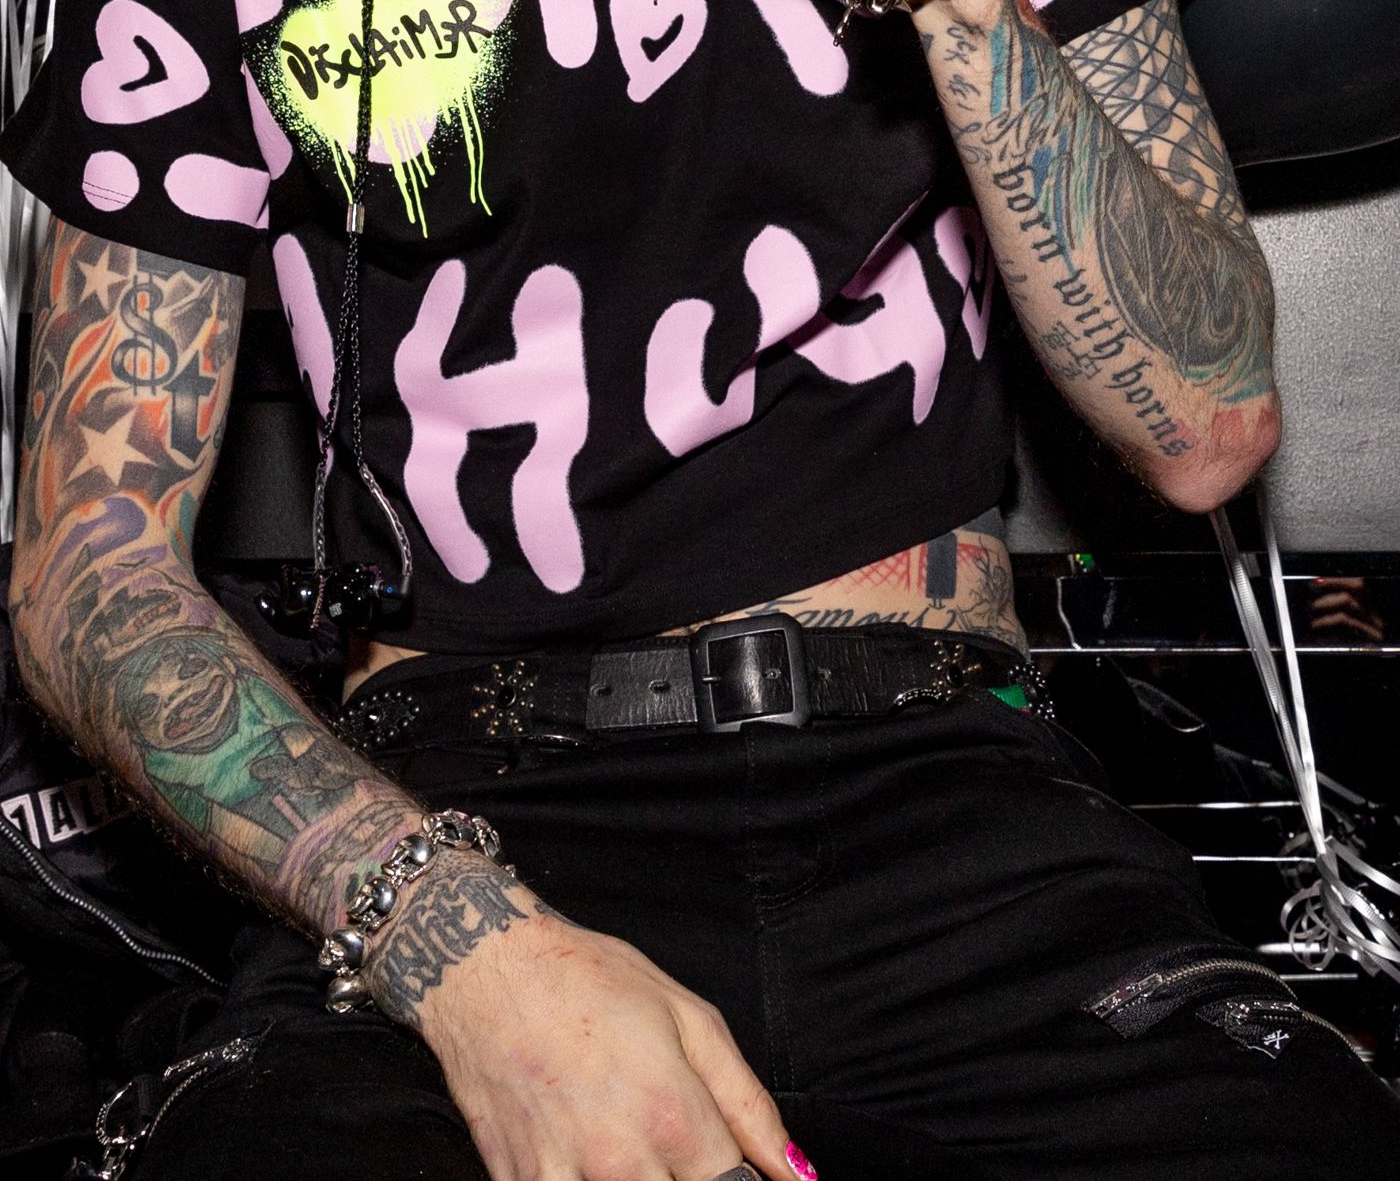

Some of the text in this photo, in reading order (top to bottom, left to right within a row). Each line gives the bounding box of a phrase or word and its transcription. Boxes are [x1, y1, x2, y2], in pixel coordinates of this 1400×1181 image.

[994, 160, 1065, 262] born
[1055, 269, 1134, 360] with
[1110, 356, 1193, 458] horns
